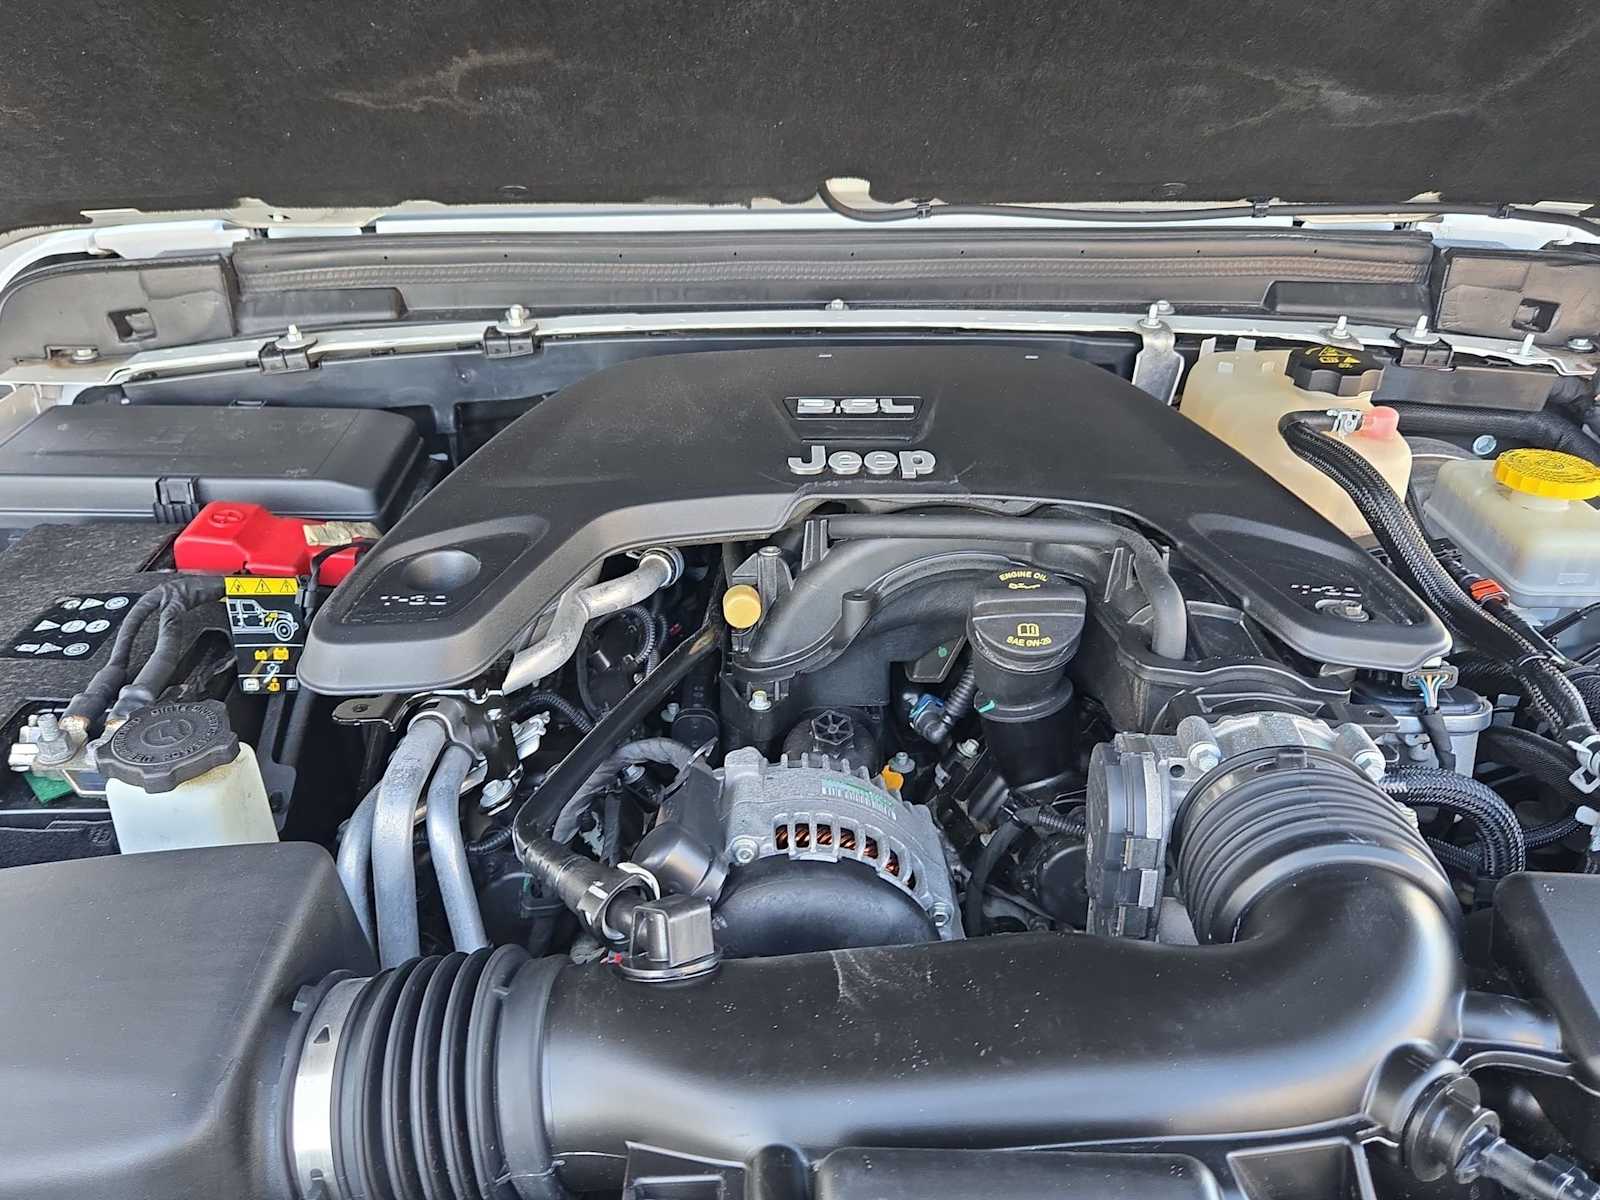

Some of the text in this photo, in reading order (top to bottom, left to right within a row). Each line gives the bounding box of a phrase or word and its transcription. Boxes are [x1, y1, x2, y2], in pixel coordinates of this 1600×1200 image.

[787, 445, 936, 479] Jeep
[999, 571, 1048, 581] ENGINE OIL
[1007, 636, 1025, 646] SAE
